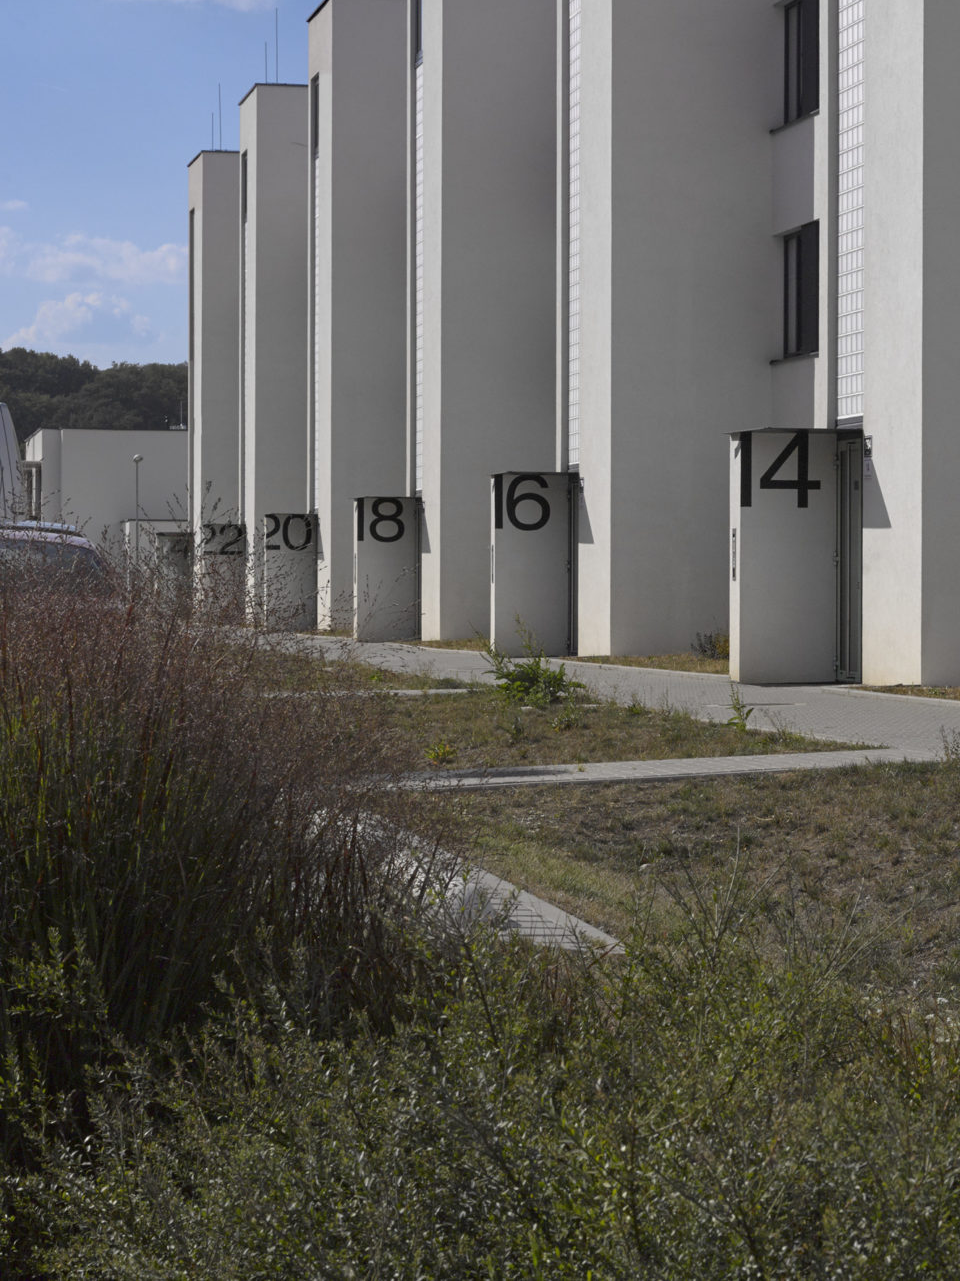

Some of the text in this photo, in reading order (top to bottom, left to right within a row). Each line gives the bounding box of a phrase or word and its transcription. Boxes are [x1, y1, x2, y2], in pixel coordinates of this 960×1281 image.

[740, 430, 821, 508] 14
[357, 498, 405, 542] 18
[494, 475, 551, 531] 16
[203, 524, 244, 555] 22
[265, 514, 313, 550] 20
